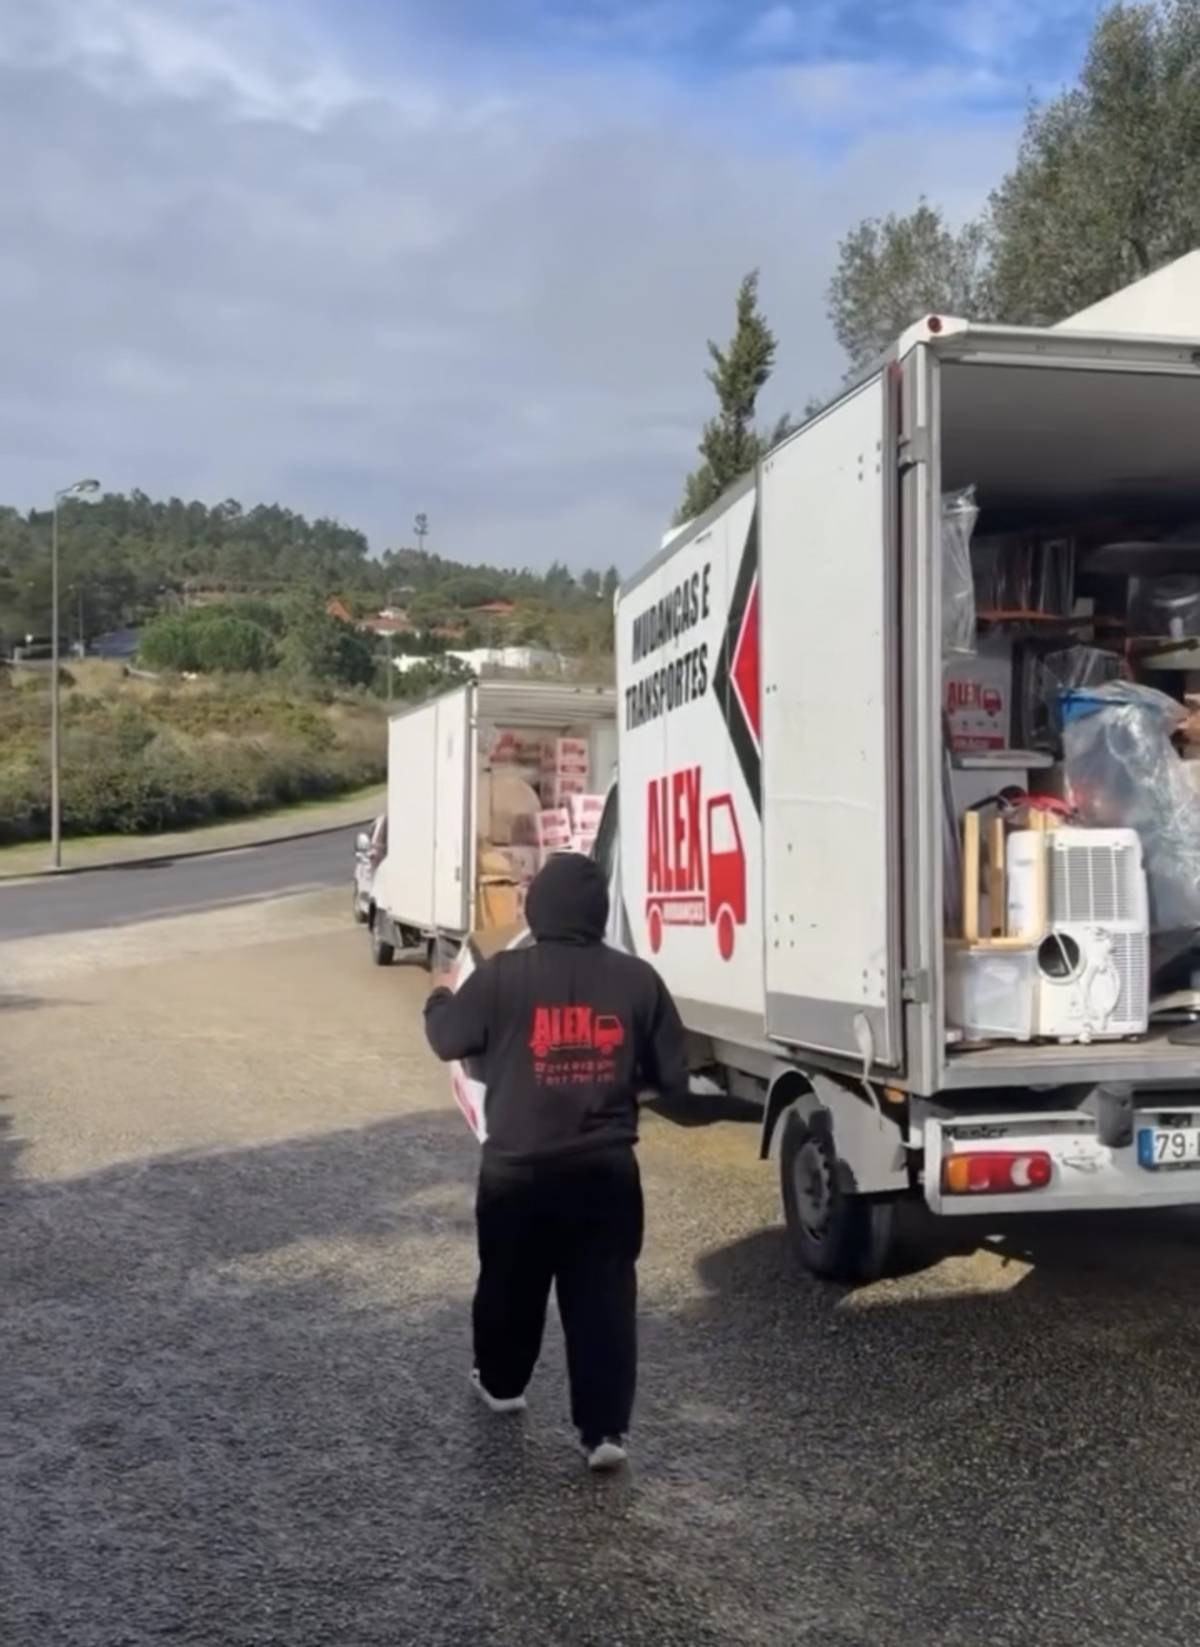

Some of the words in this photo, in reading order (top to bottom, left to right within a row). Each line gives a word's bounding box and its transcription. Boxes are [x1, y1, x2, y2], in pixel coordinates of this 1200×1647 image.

[701, 562, 711, 620] E
[625, 642, 708, 731] TRANSPORTES
[647, 765, 704, 893] ALEX
[534, 1006, 593, 1045] ALEX
